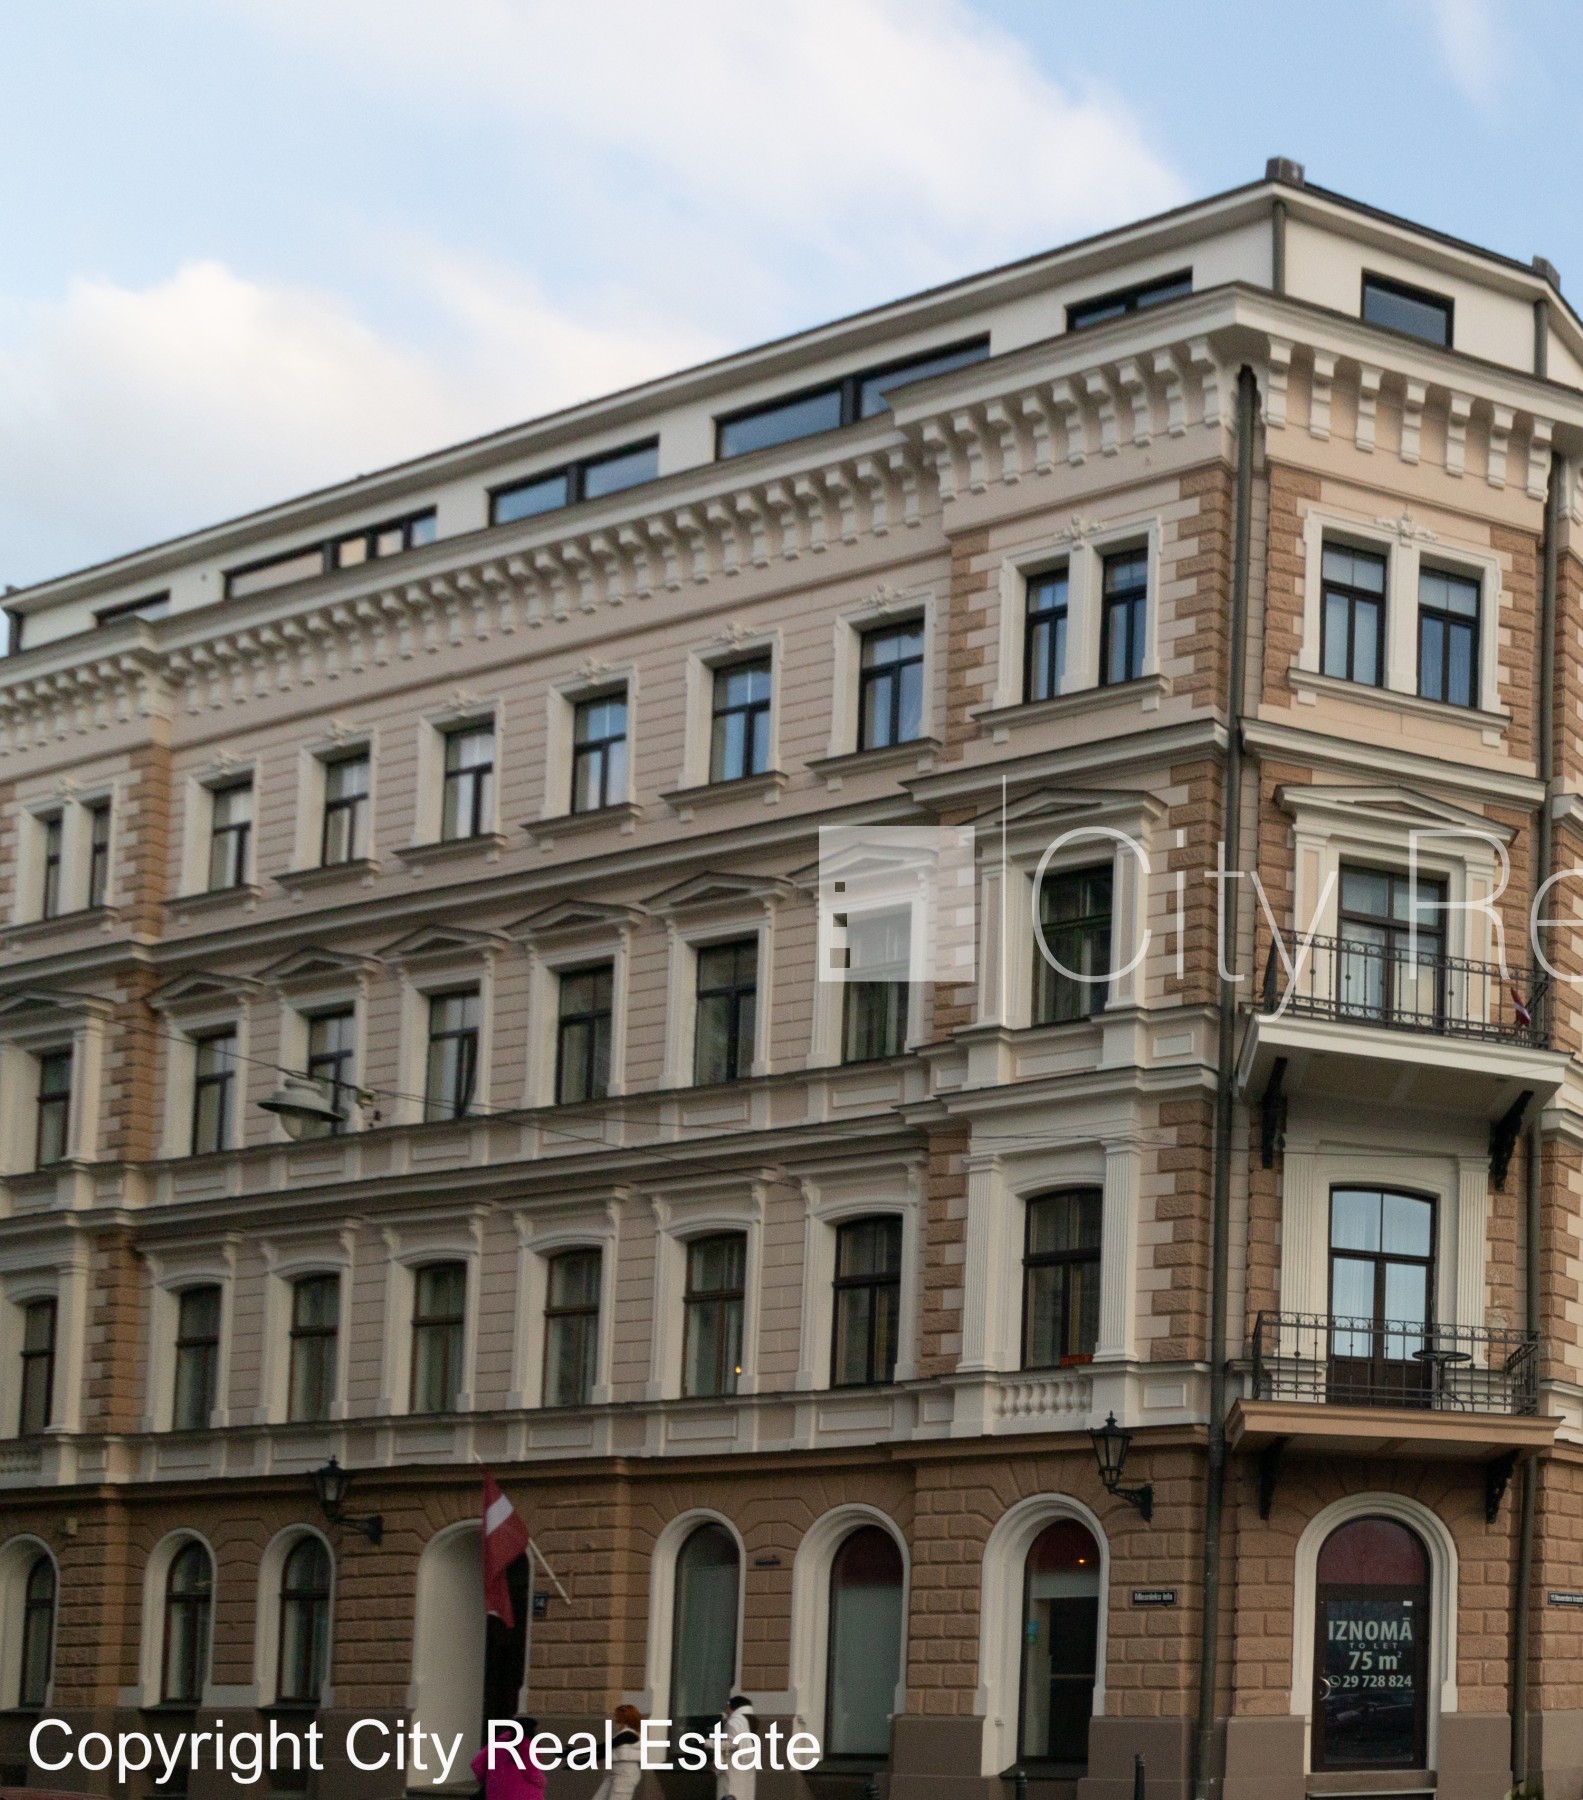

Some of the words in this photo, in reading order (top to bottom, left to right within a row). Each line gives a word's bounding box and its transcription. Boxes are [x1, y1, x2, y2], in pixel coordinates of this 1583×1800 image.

[1328, 1616, 1413, 1641] IZNOMĀ
[1349, 1642, 1366, 1650] TO
[1373, 1642, 1397, 1650] LET
[1348, 1651, 1373, 1671] 75
[1342, 1675, 1359, 1688] 29
[1362, 1675, 1386, 1688] 728
[1388, 1675, 1413, 1688] 824
